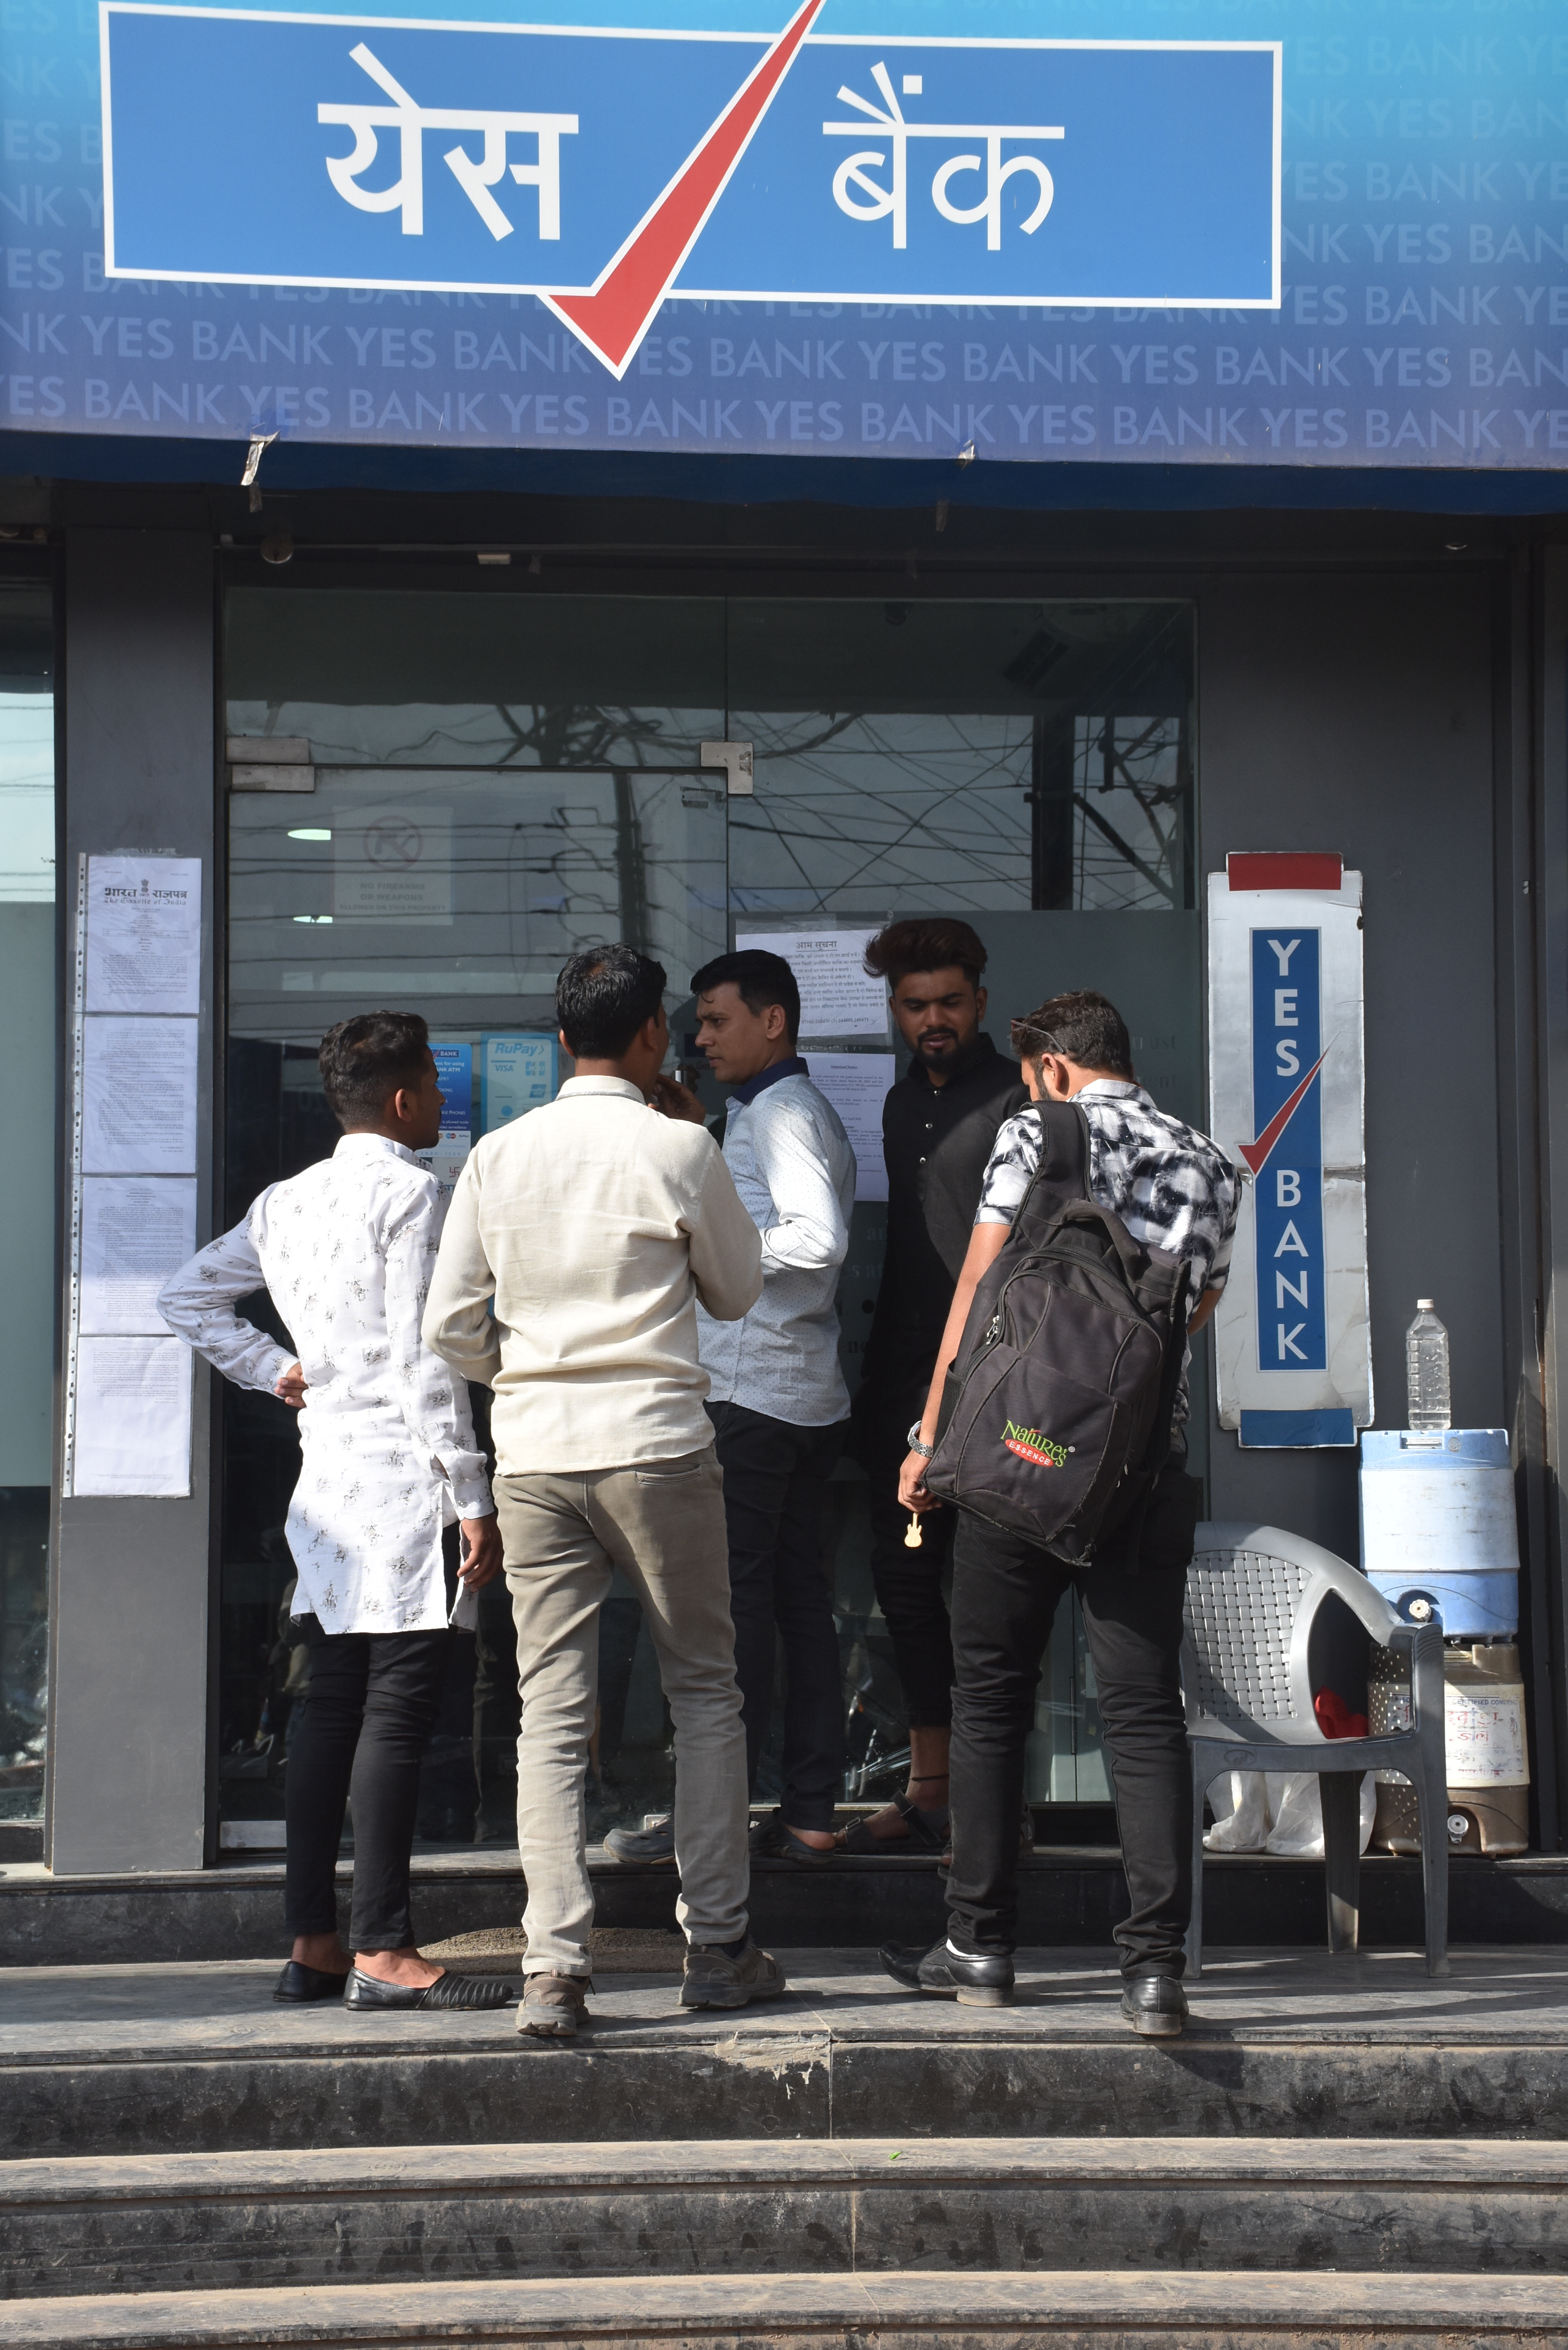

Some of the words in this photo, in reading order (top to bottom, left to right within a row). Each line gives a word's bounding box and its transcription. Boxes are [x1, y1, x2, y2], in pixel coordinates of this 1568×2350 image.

[1, 0, 57, 33] ES
[1283, 35, 1349, 76] ES
[1367, 35, 1504, 76] BANK
[1517, 34, 1568, 76] YE
[0, 55, 63, 98] NK
[1283, 98, 1351, 139] NK
[1364, 98, 1454, 139] YES
[1471, 98, 1568, 139] BAN
[4, 119, 62, 163] ES
[318, 42, 579, 241] येस
[823, 61, 1065, 250] बैंक
[1366, 161, 1502, 202] BANK
[1515, 161, 1568, 201] YE
[0, 185, 66, 227] NK
[1282, 223, 1351, 263] NK
[1362, 223, 1452, 264] YES
[1470, 223, 1568, 264] BAN
[0, 247, 64, 291] ES
[1366, 285, 1502, 325] BANK
[1513, 285, 1568, 325] YE
[0, 313, 69, 355] NK
[80, 314, 174, 359] YES
[192, 320, 334, 365] BANK
[345, 326, 437, 370] YES
[454, 330, 592, 373] BANK
[639, 336, 693, 376] ES
[710, 338, 846, 379] BANK
[857, 340, 947, 382] YES
[964, 342, 1099, 384] BANK
[1109, 344, 1199, 386] YES
[1216, 346, 1351, 387] BANK
[1362, 347, 1452, 388] YES
[1469, 347, 1568, 388] BAN
[0, 374, 66, 418] ES
[84, 378, 228, 424] BANK
[238, 385, 332, 429] YES
[348, 389, 489, 433] BANK
[499, 394, 590, 436] YES
[607, 397, 743, 440] BANK
[754, 400, 844, 442] YES
[861, 402, 996, 444] BANK
[1007, 404, 1097, 445] YES
[1113, 406, 1249, 446] BANK
[1260, 408, 1348, 448] YES
[1366, 408, 1502, 448] BANK
[1513, 409, 1568, 448] YE
[105, 888, 137, 897] भारत
[152, 890, 188, 898] राजपत्र
[815, 941, 838, 951] सूचना
[1267, 939, 1301, 1077] YES
[494, 1042, 538, 1057] RuPay
[1274, 1169, 1309, 1360] BANK
[1009, 1441, 1051, 1466] ESSENCE
